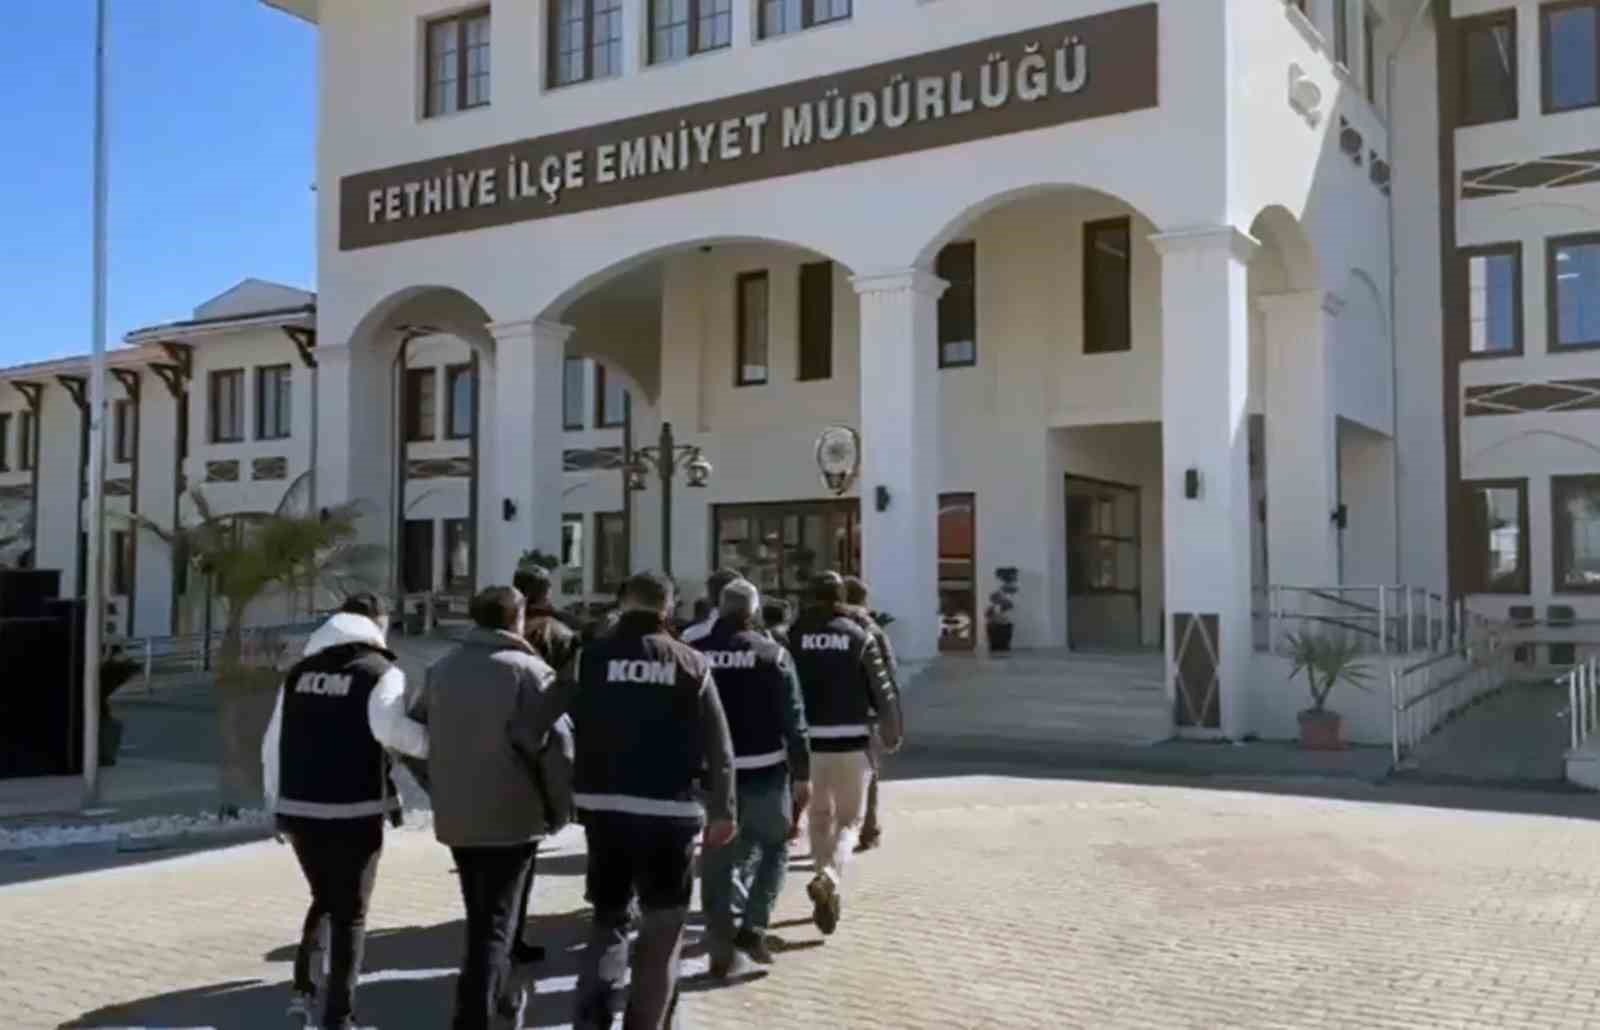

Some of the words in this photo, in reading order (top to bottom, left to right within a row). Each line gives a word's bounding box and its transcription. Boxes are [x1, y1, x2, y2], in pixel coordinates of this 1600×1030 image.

[367, 167, 498, 225] FETHİYE
[507, 147, 585, 204] İLÇE
[596, 111, 768, 184] EMNİYET
[781, 35, 1089, 149] MÜDÜRLÜĞÜ
[801, 632, 850, 650] KOM
[295, 671, 352, 697] KOM
[607, 659, 677, 686] KOM
